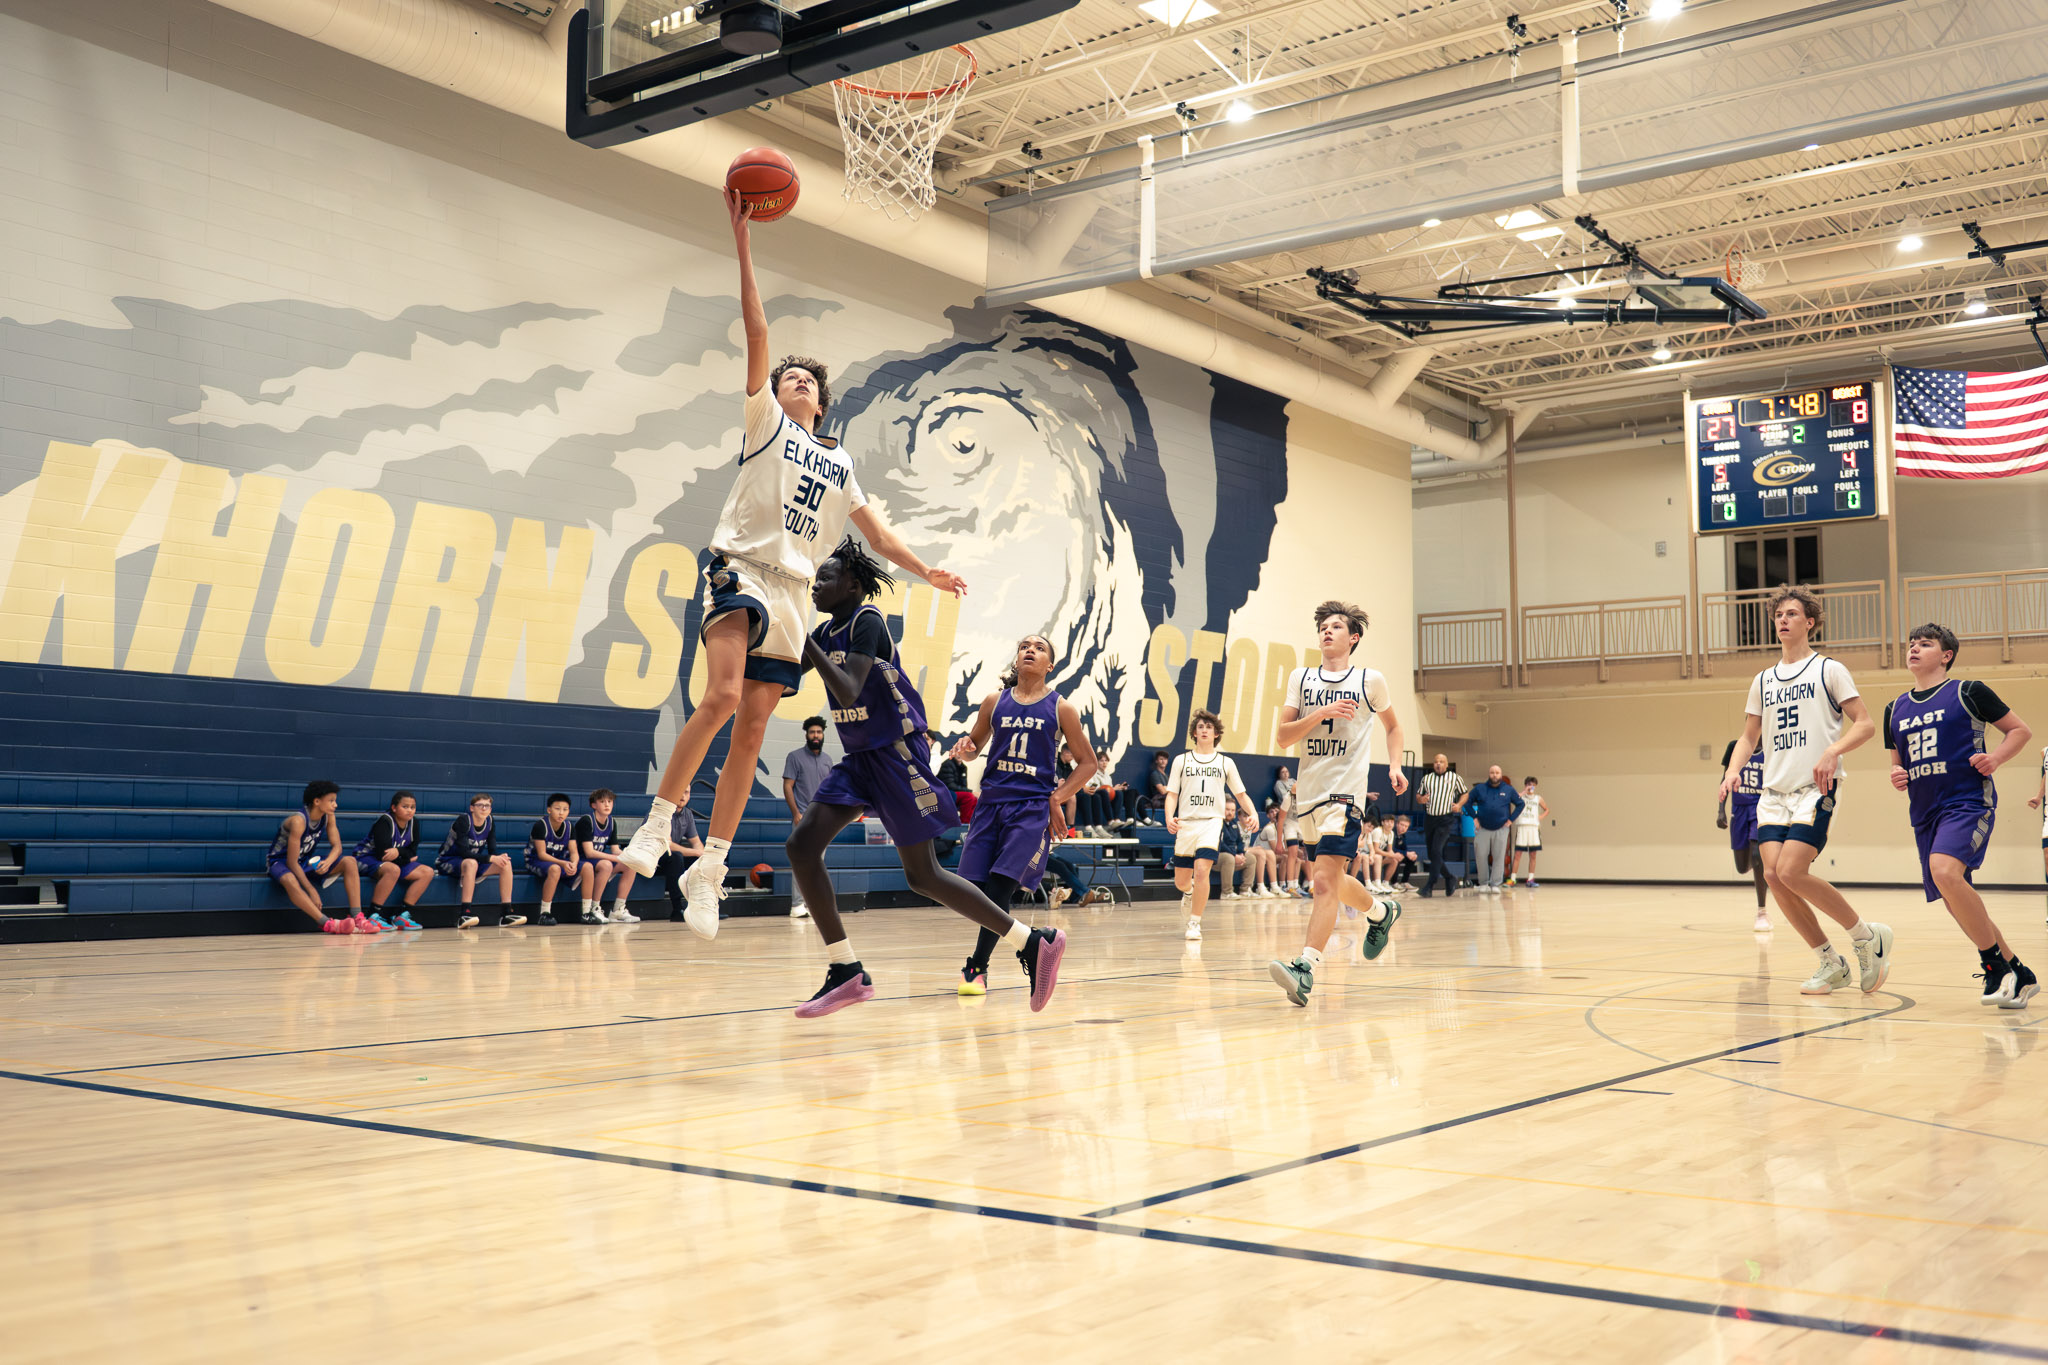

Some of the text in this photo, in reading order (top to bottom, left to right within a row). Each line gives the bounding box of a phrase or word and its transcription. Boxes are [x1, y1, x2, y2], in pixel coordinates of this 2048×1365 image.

[1760, 393, 1820, 420] 7:48
[1853, 400, 1868, 424] 8
[1707, 416, 1736, 440] 27
[1760, 430, 1789, 441] PERIOD
[1792, 425, 1805, 443] 2
[1827, 428, 1854, 439] BONUS
[1713, 441, 1740, 451] BONUS
[1773, 449, 1792, 458] South
[1828, 440, 1869, 452] TIMEOUTS
[783, 439, 849, 490] ELKHORN
[1701, 454, 1740, 466] TIMEOUTS
[1843, 450, 1856, 468] 4
[1714, 464, 1727, 482] 5
[1780, 463, 1815, 475] STORM
[1840, 469, 1859, 479] LEFT
[793, 474, 827, 512] 30
[1712, 482, 1730, 492] LEFT
[1758, 485, 1818, 499] PLAYER FOULS
[1834, 481, 1860, 491] FOULS
[1712, 493, 1736, 503] FOULS
[1848, 490, 1861, 509] 0
[1724, 502, 1736, 520] 0
[1138, 623, 1322, 758] STOR
[1303, 688, 1360, 709] ELKHORN
[1764, 682, 1816, 708] ELKHORN
[831, 705, 869, 723] HIGH
[1001, 716, 1045, 730] EAST
[1777, 705, 1799, 730] 35
[1899, 709, 1945, 731] EAST
[1008, 732, 1029, 759] 11
[1307, 738, 1347, 756] SOUTH
[1773, 730, 1807, 752] SOUTH
[1907, 728, 1938, 763] 22
[997, 760, 1037, 776] HIGH
[1185, 766, 1222, 778] ELKHORN
[1745, 761, 1764, 770] AST
[1909, 761, 1947, 781] HIGH
[1201, 779, 1205, 793] 1
[1743, 769, 1759, 787] 15
[1190, 795, 1214, 807] SOUTH
